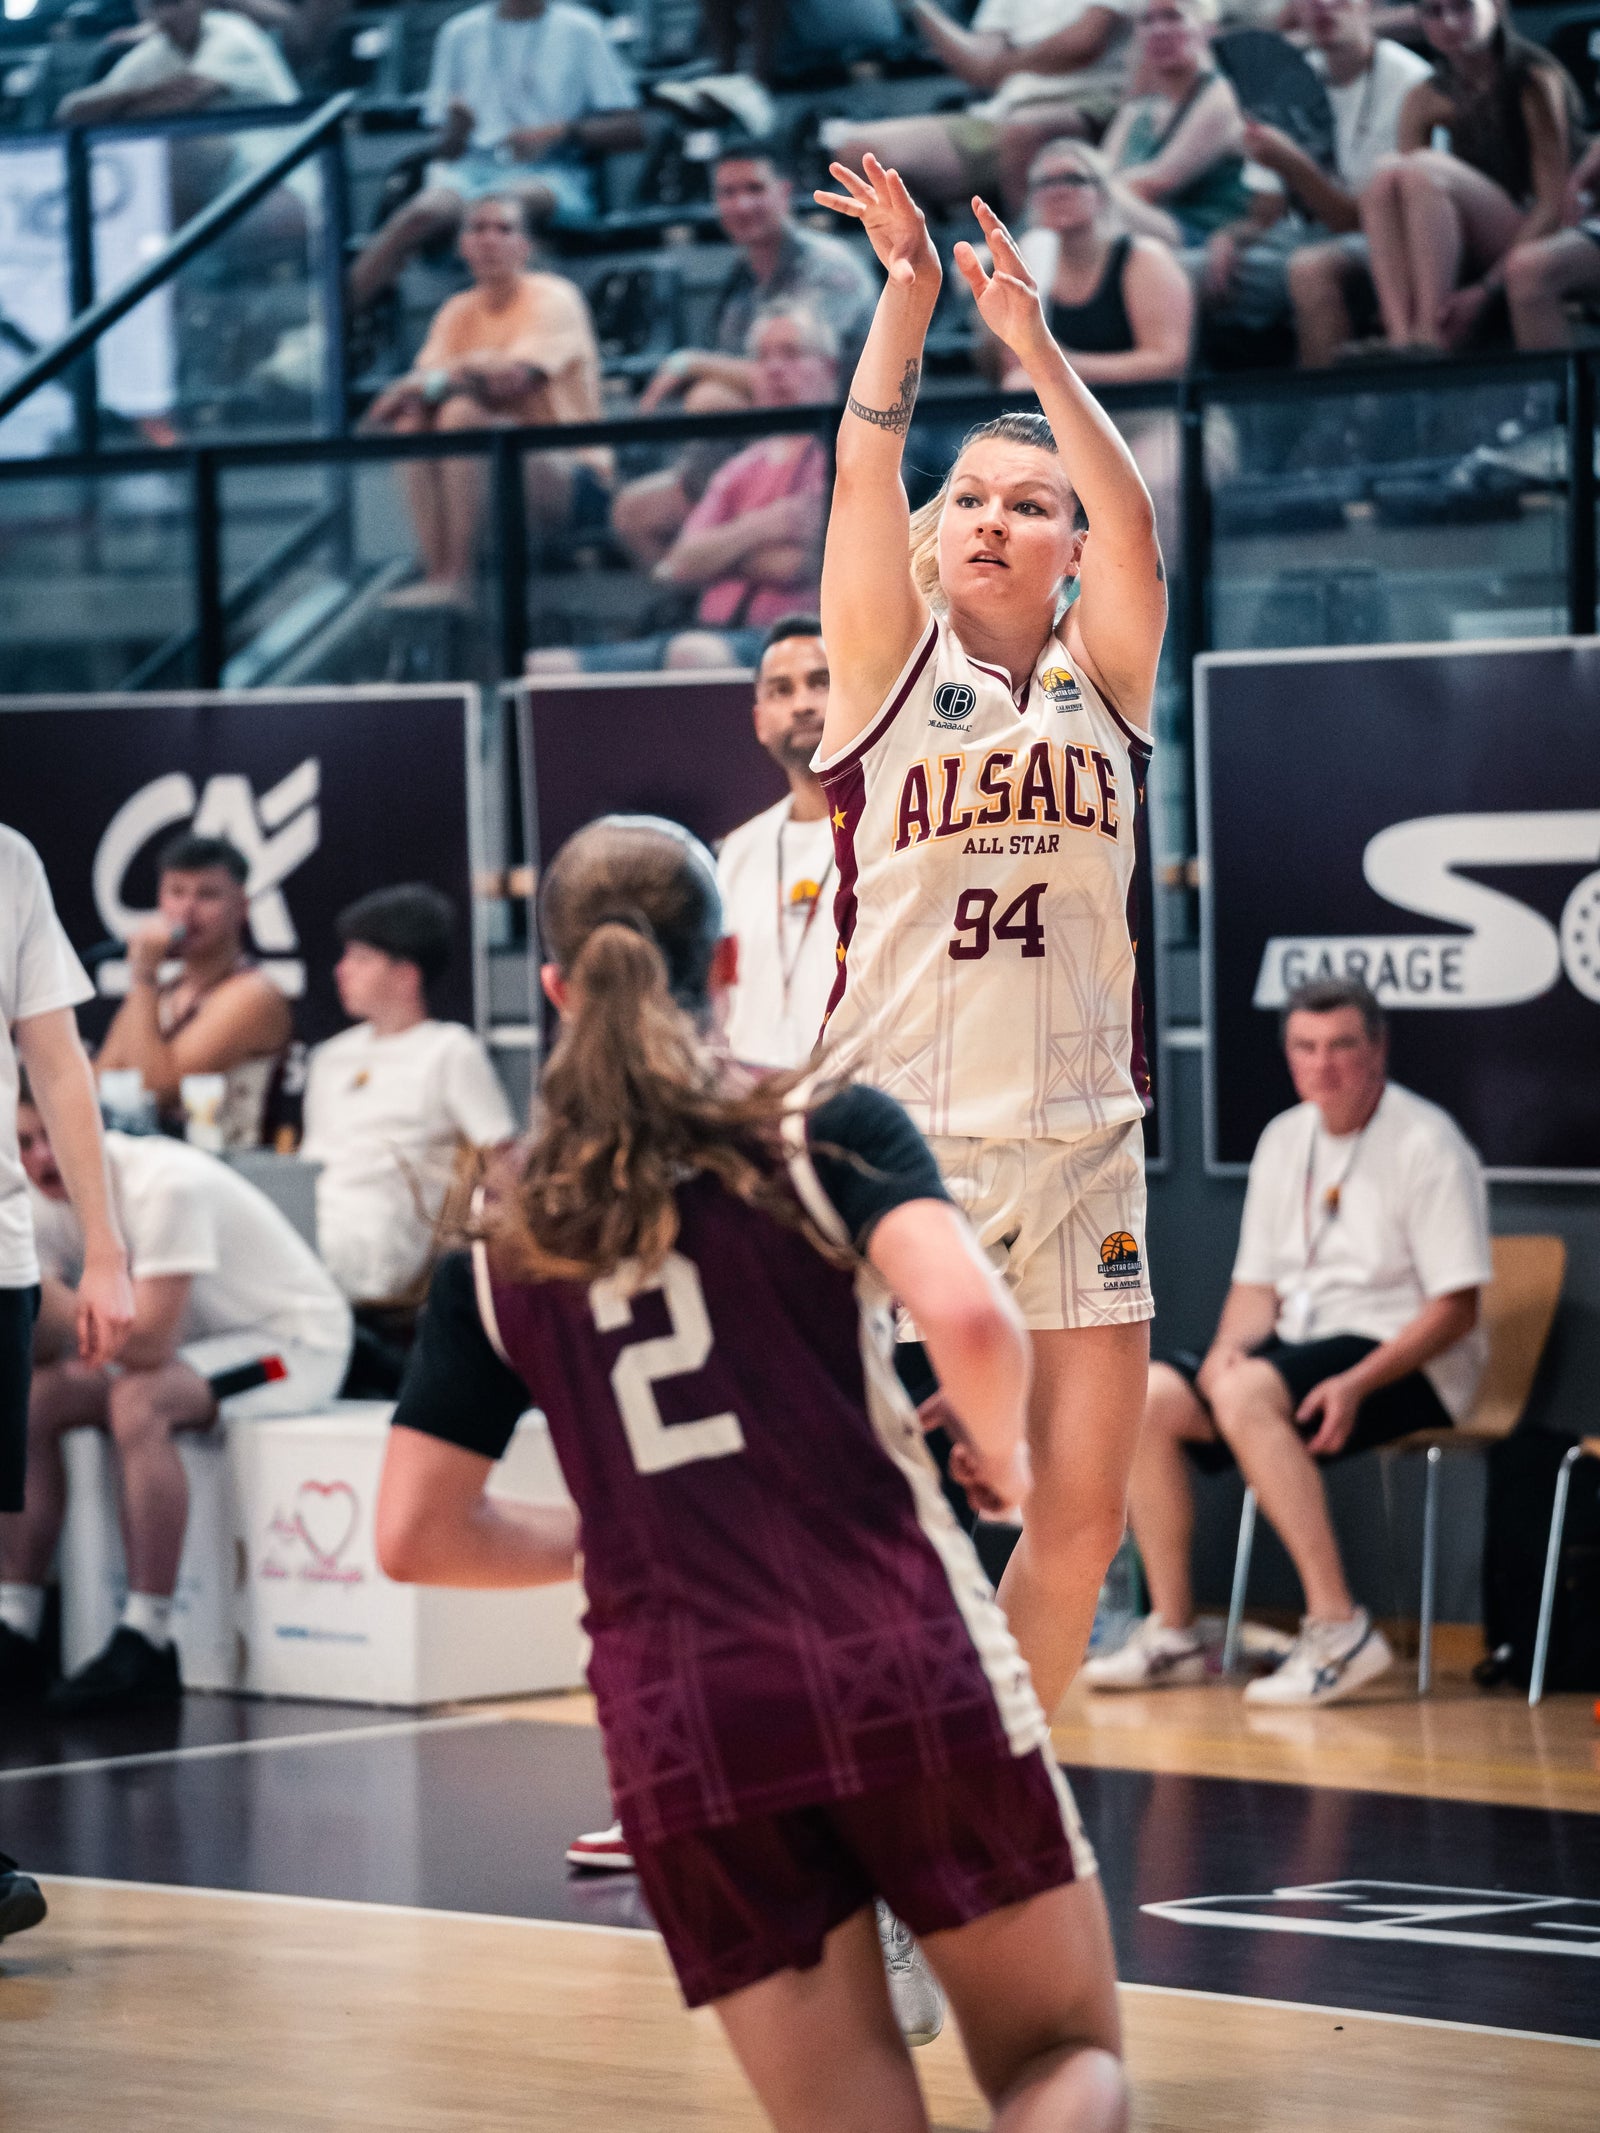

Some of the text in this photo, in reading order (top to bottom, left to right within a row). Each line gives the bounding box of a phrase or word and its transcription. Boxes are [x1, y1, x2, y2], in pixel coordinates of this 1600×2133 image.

[892, 738, 1120, 856] ALSACE
[962, 834, 1060, 855] ALL STAR
[947, 882, 1048, 961] 94
[589, 1251, 747, 1475] 2
